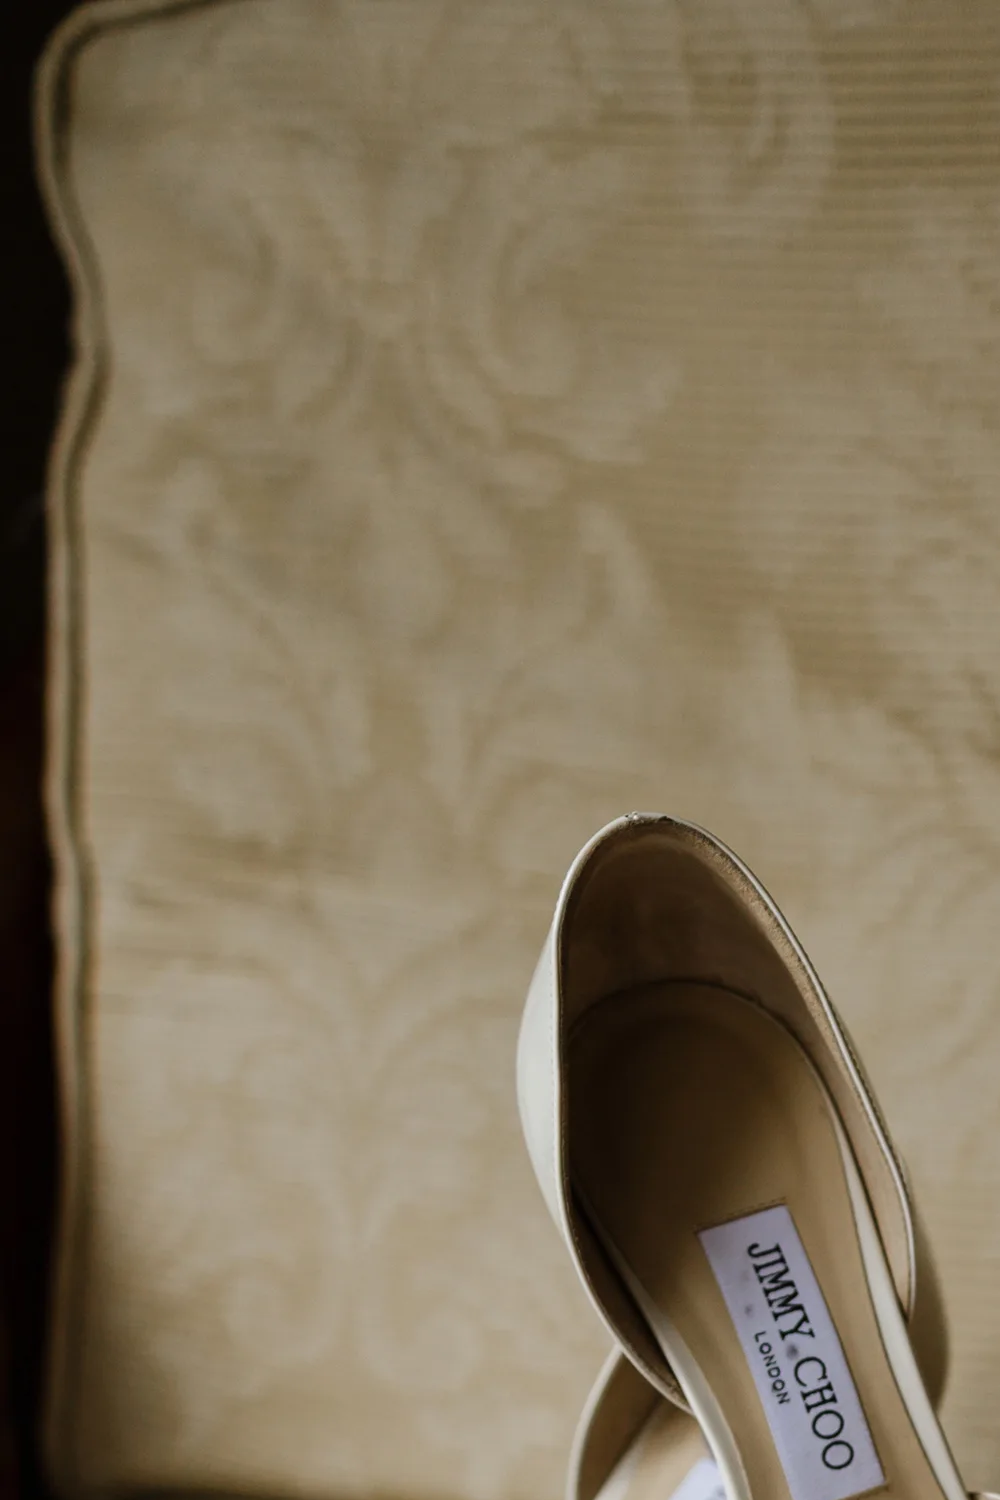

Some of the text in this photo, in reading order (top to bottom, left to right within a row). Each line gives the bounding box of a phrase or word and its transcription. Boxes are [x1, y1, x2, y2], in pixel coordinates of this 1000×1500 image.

[747, 1242, 855, 1470] JIMMY CHOO
[753, 1331, 790, 1405] LONDON
